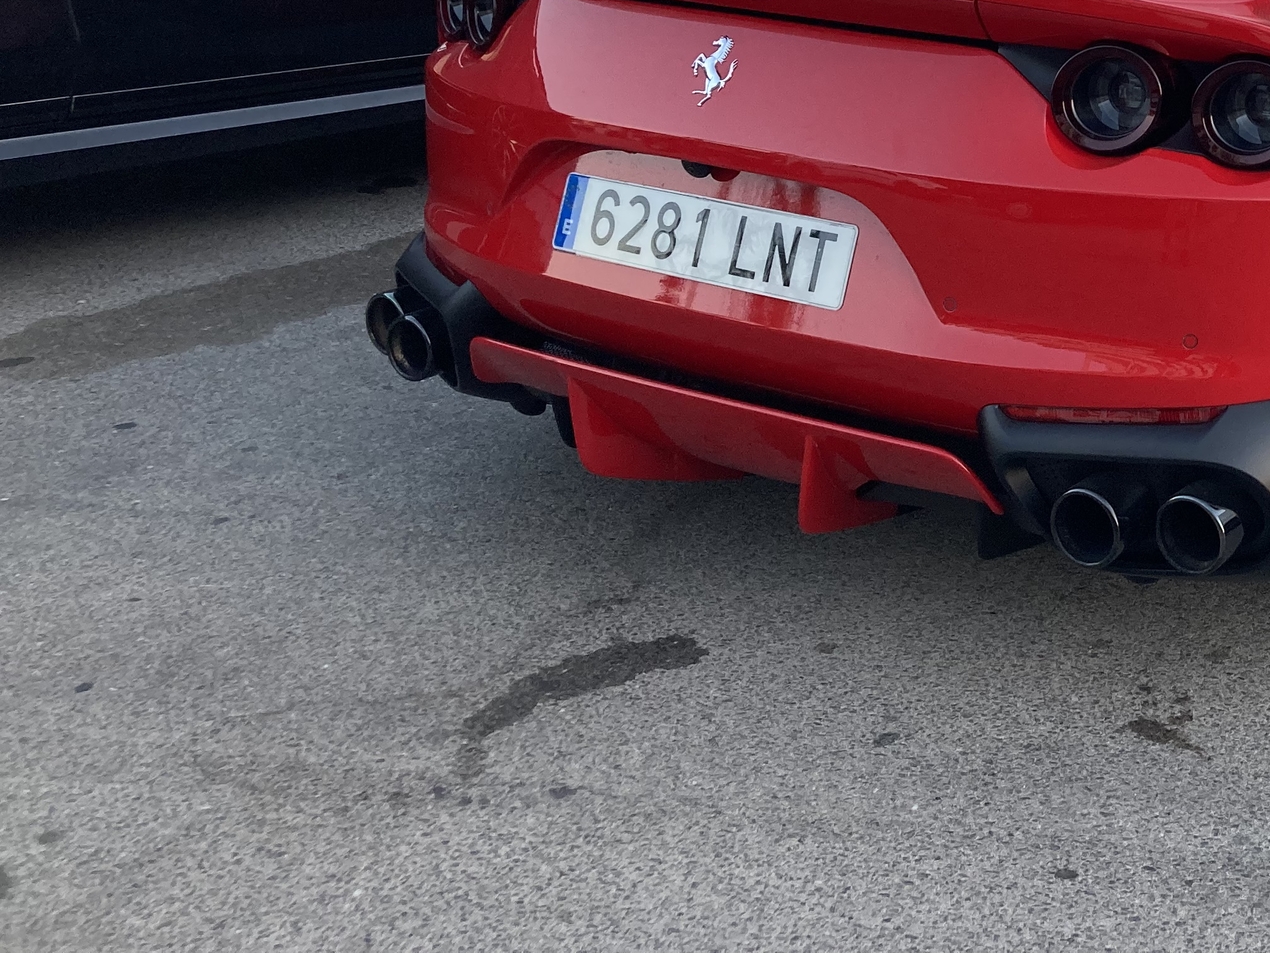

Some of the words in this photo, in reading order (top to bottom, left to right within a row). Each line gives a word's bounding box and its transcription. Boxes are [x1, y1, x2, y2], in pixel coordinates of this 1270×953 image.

[562, 218, 574, 235] E
[590, 189, 711, 268] 6281
[728, 215, 839, 293] LNT
